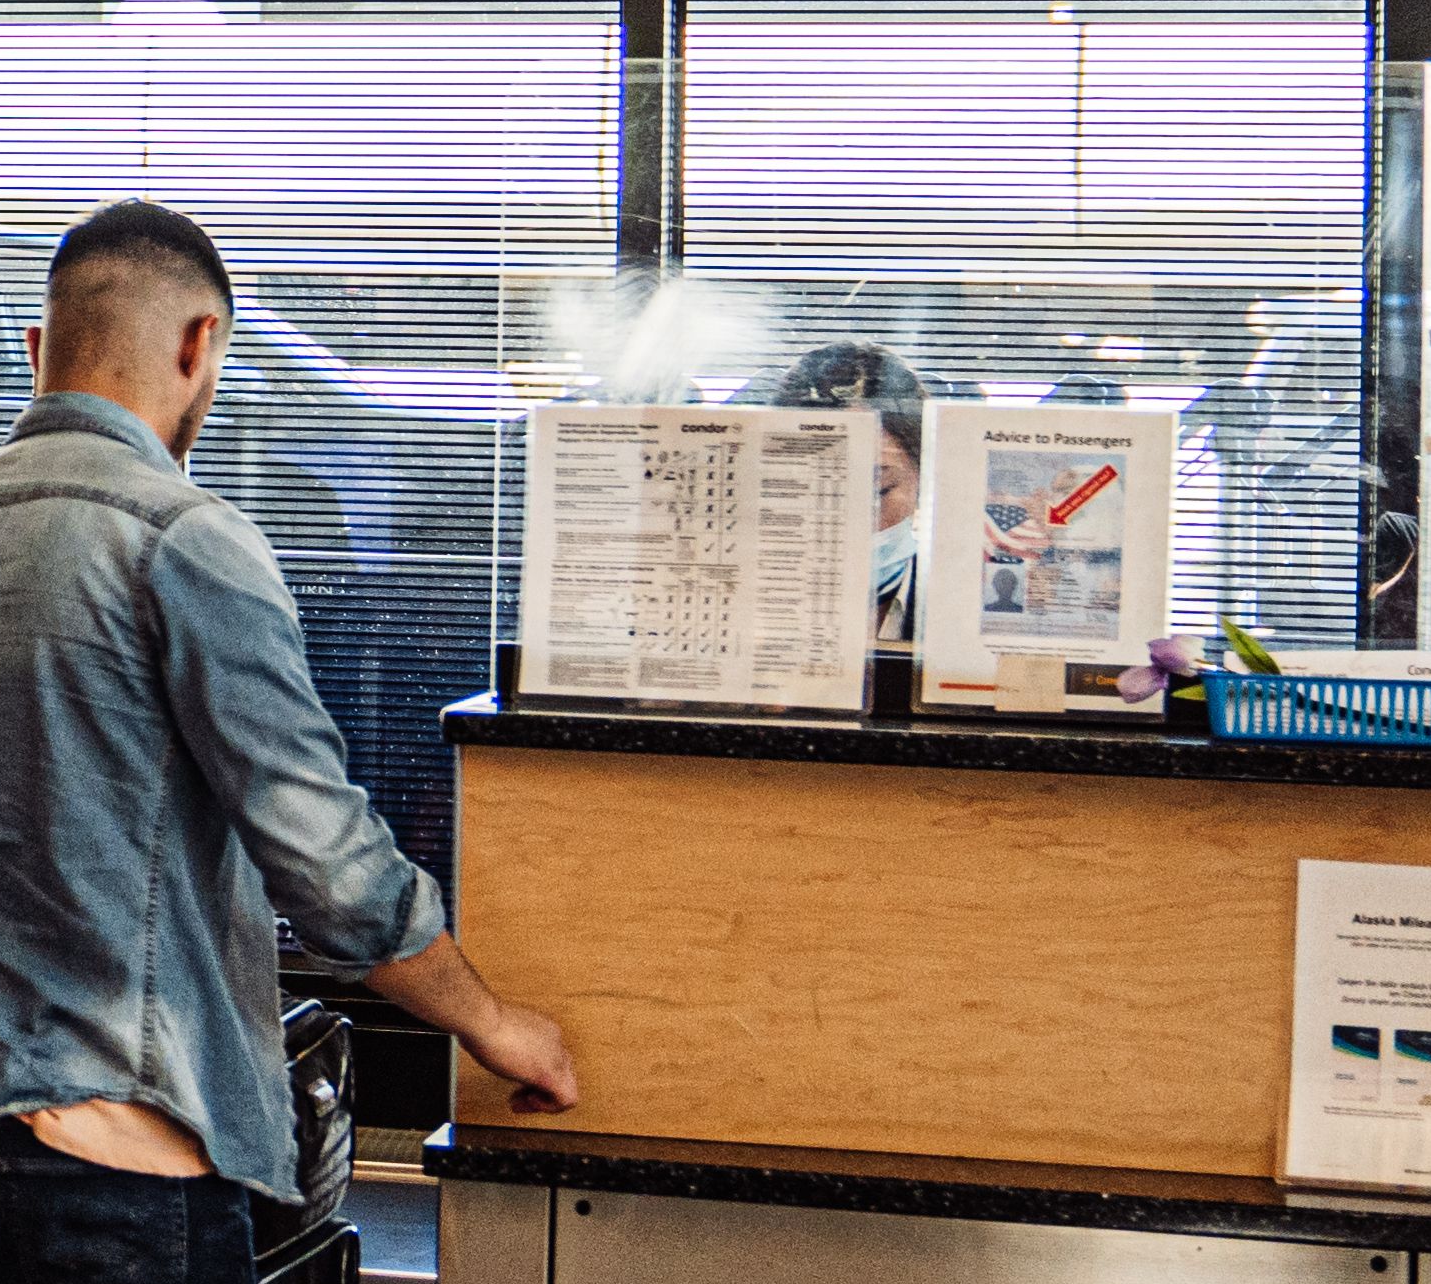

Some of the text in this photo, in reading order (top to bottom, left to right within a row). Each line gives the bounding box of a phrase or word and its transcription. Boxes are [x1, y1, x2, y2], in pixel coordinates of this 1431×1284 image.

[982, 428, 1134, 451] Advice to Passengers
[1352, 913, 1396, 926] Alaska
